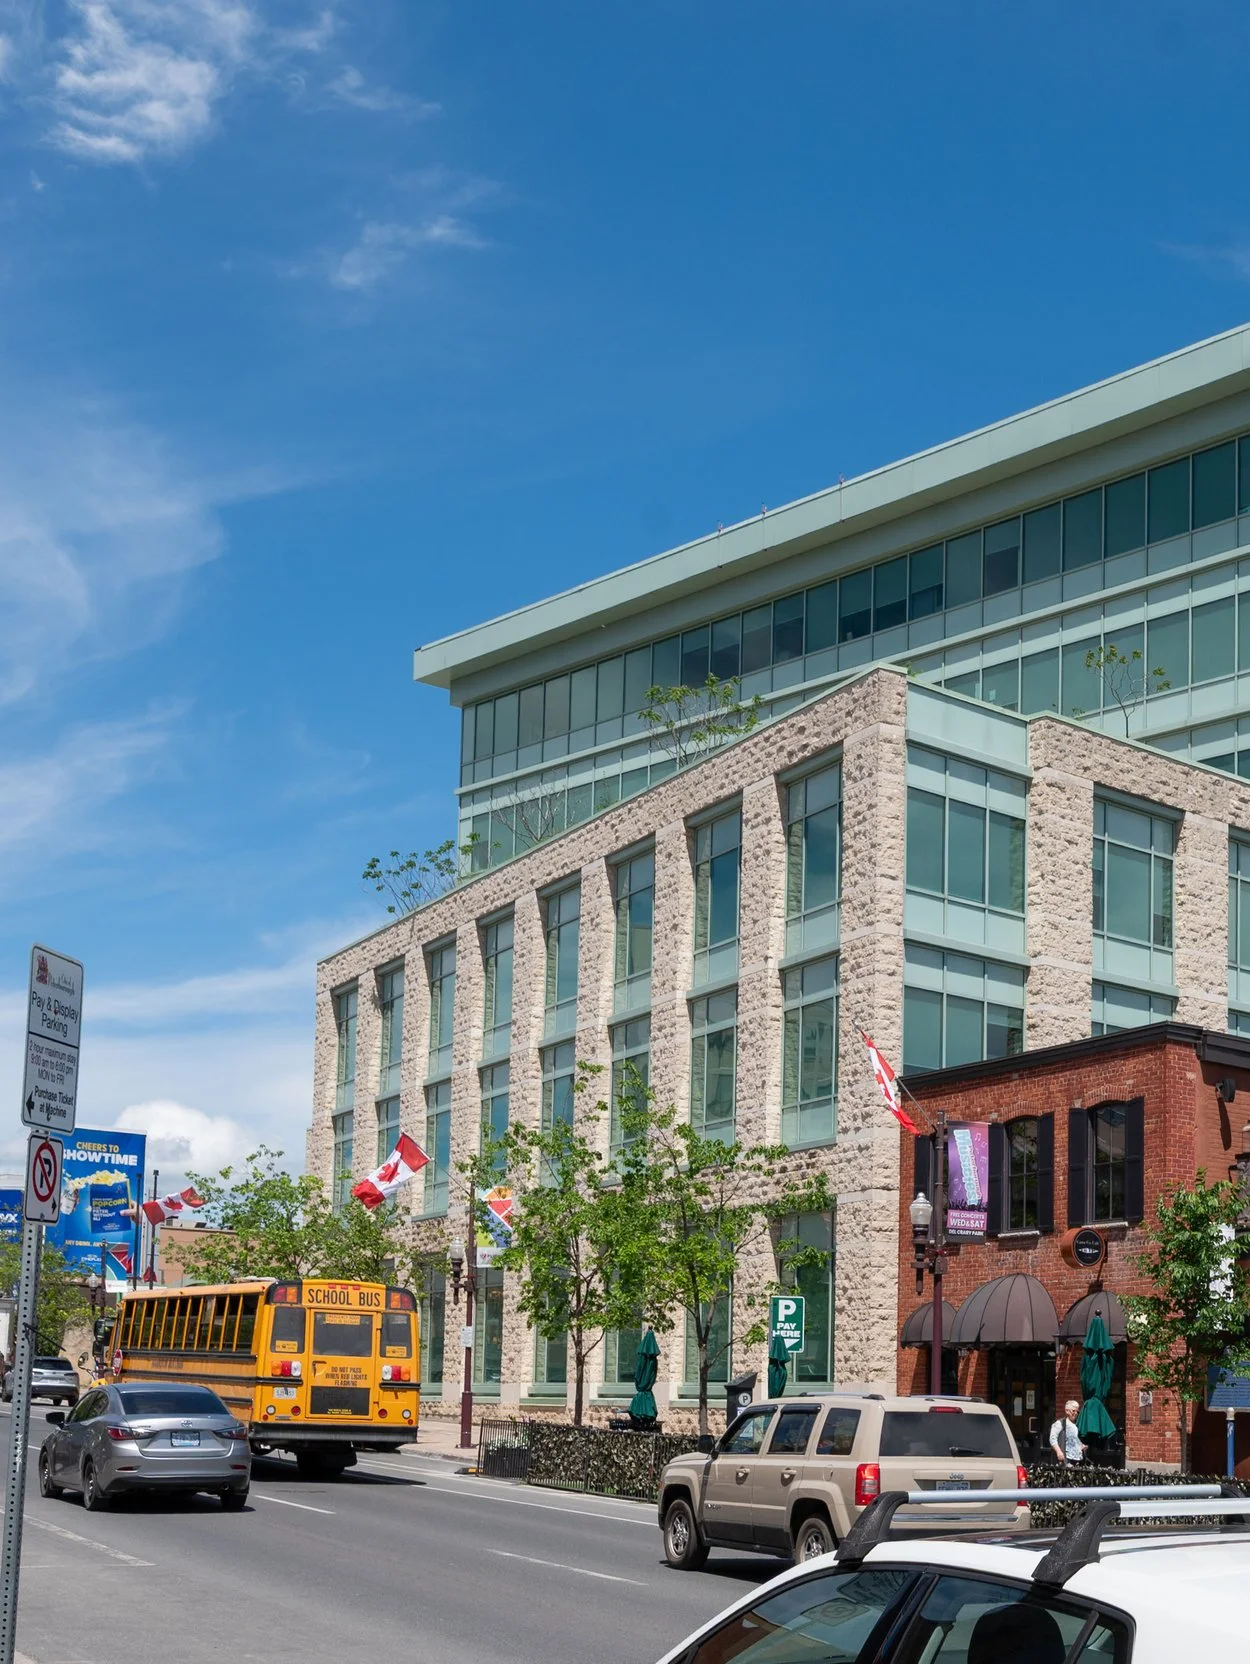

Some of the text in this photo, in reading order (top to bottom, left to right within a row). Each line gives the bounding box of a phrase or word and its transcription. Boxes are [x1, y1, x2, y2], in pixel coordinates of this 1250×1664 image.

[32, 991, 79, 1024] Pay & Display
[41, 1013, 68, 1038] Parking
[33, 1041, 44, 1055] hour
[45, 1046, 66, 1060] maximum
[67, 1053, 76, 1067] stay
[38, 1068, 50, 1082] MON
[34, 1085, 74, 1107] Purchase Ticket
[46, 1103, 67, 1118] Machine
[76, 1142, 119, 1153] CHEERS TO
[953, 1129, 979, 1206] Musicfest
[92, 1197, 127, 1208] POPCORN
[308, 1288, 381, 1307] SCHOOL BUS
[778, 1300, 796, 1321] P
[949, 1472, 964, 1480] Jeep
